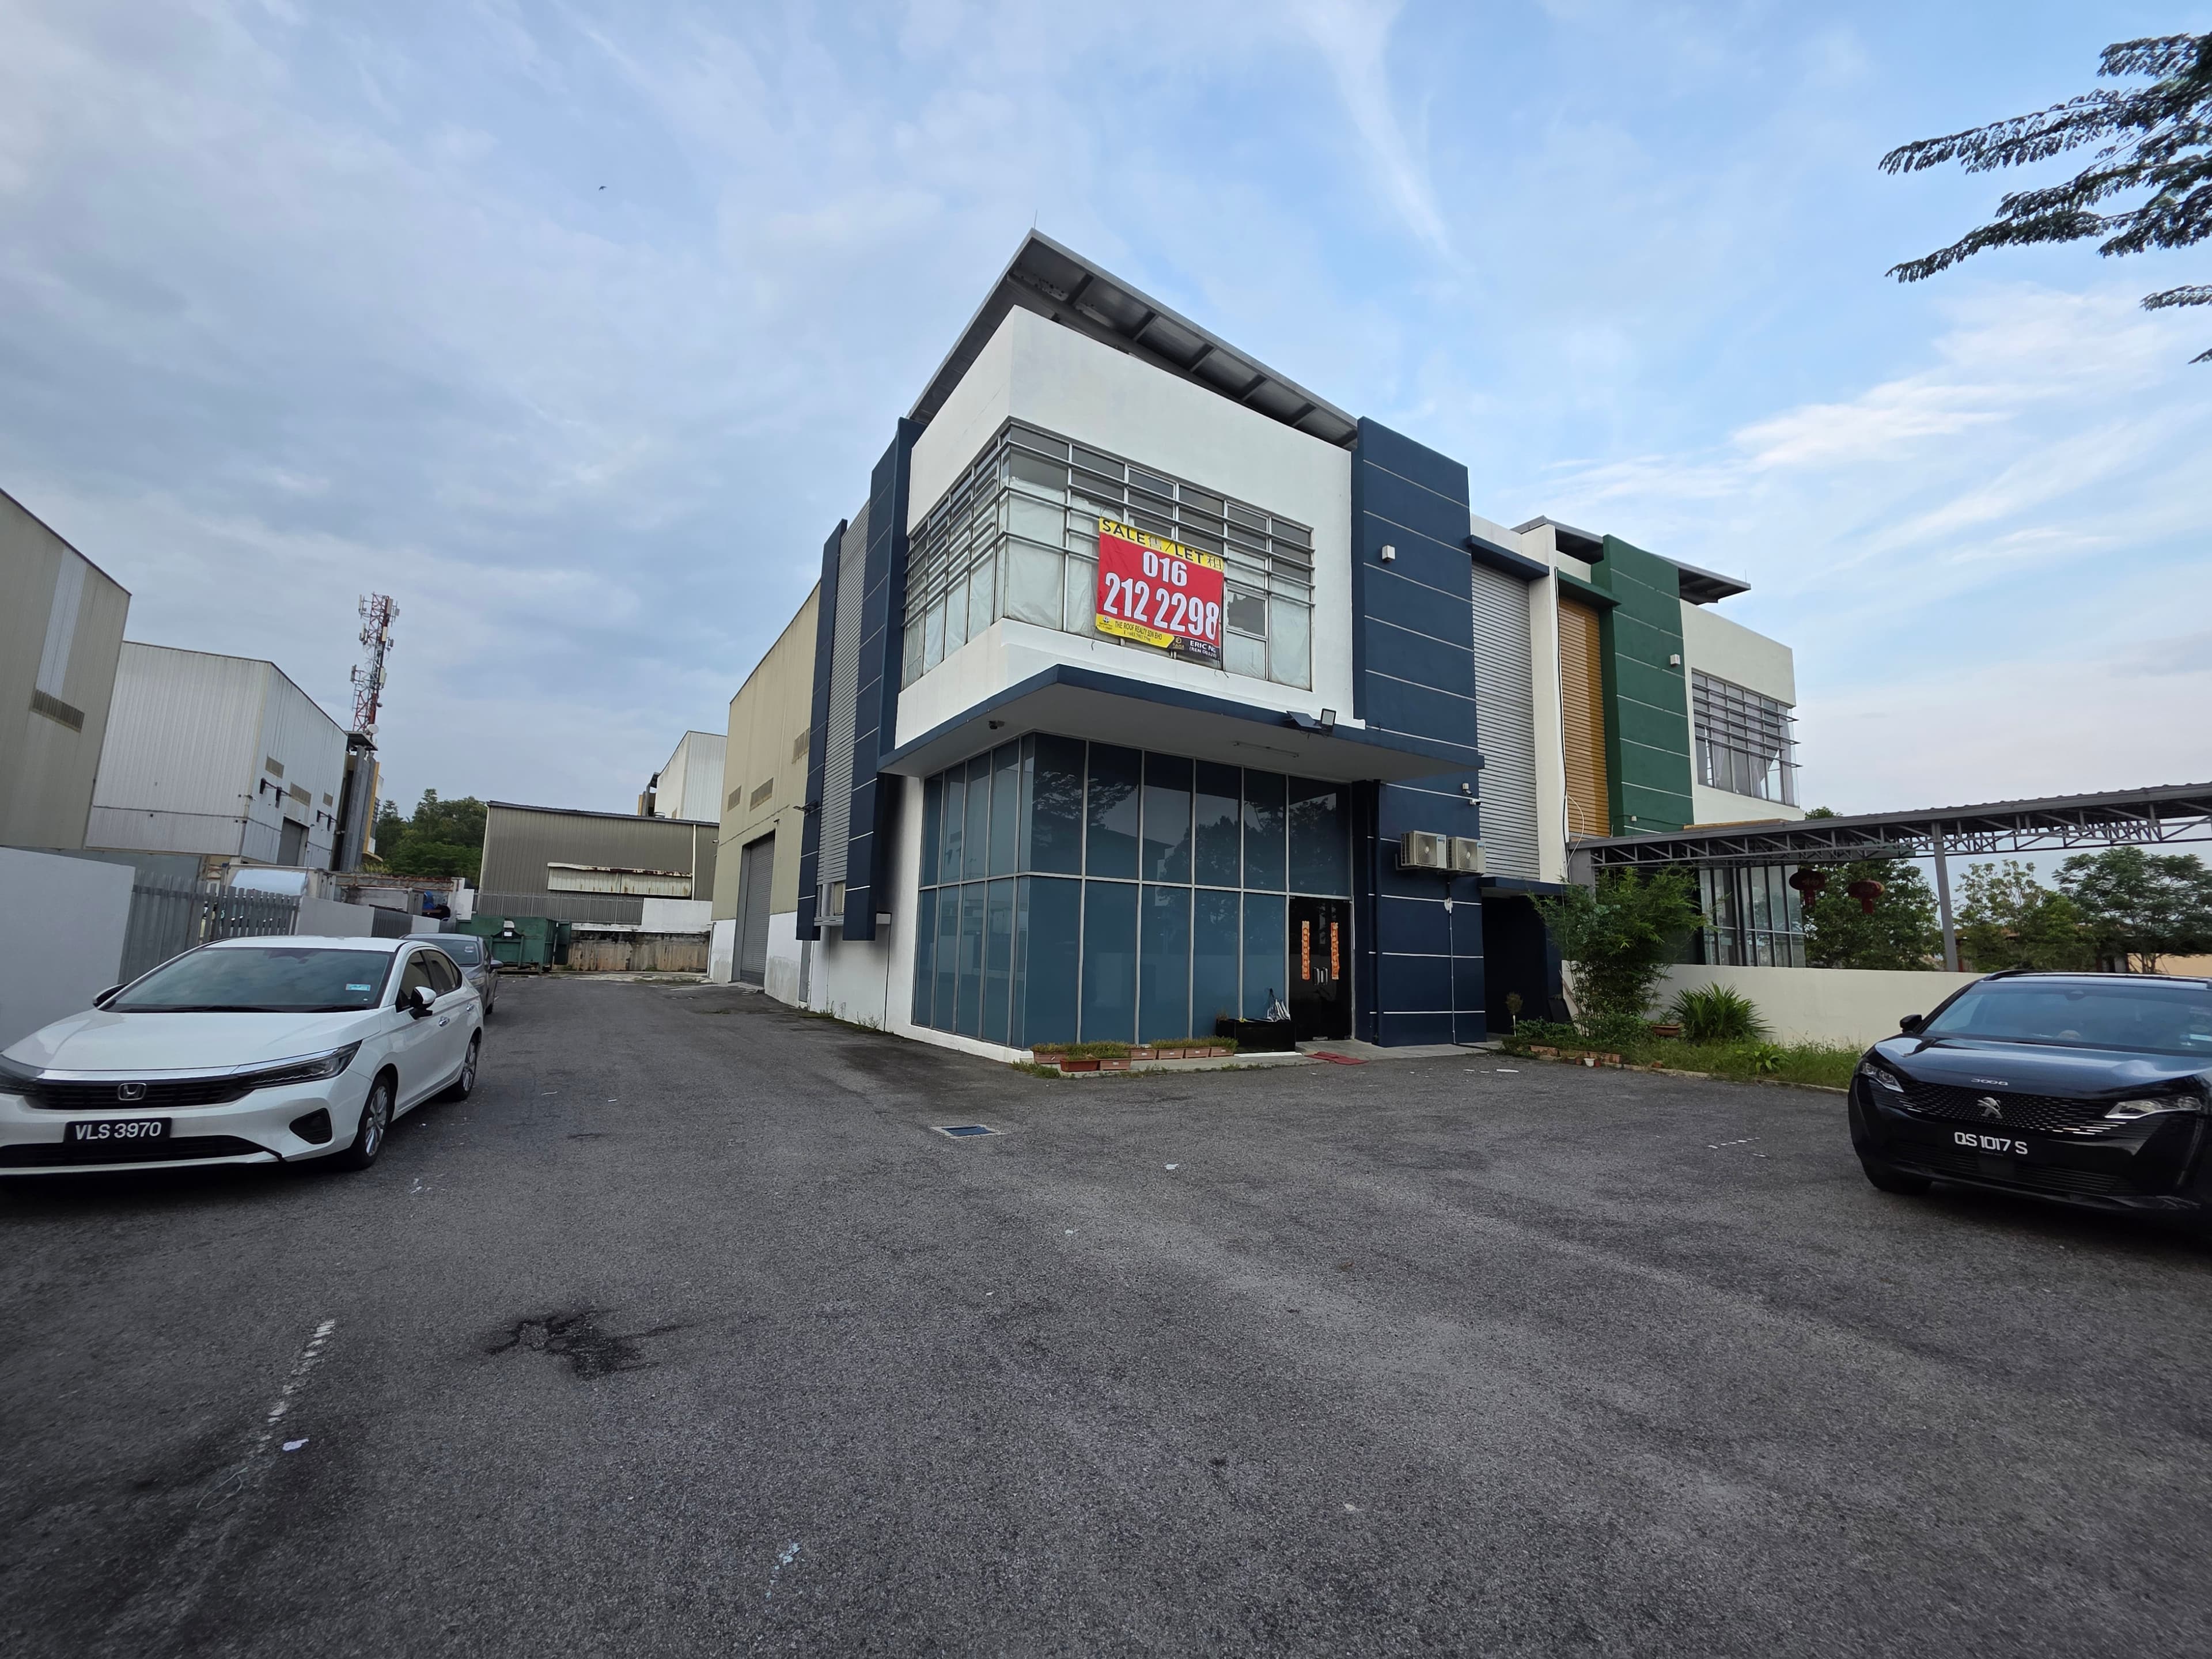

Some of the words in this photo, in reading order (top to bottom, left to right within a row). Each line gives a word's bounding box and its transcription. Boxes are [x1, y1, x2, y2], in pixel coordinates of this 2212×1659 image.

[1102, 520, 1145, 544] SALE
[1175, 544, 1204, 563] LET
[1143, 551, 1187, 586] 016
[1103, 572, 1150, 623] 212
[1154, 588, 1219, 641] 2298
[1124, 622, 1134, 630] ROOF
[1135, 625, 1147, 634] REALTY
[1190, 640, 1207, 649] ERIC
[1208, 645, 1216, 653] NG
[75, 1124, 110, 1140] VLS
[114, 1122, 162, 1138] 3970
[1954, 1131, 1978, 1147] QS
[1979, 1135, 2011, 1152] 1017
[2014, 1141, 2028, 1155] S
